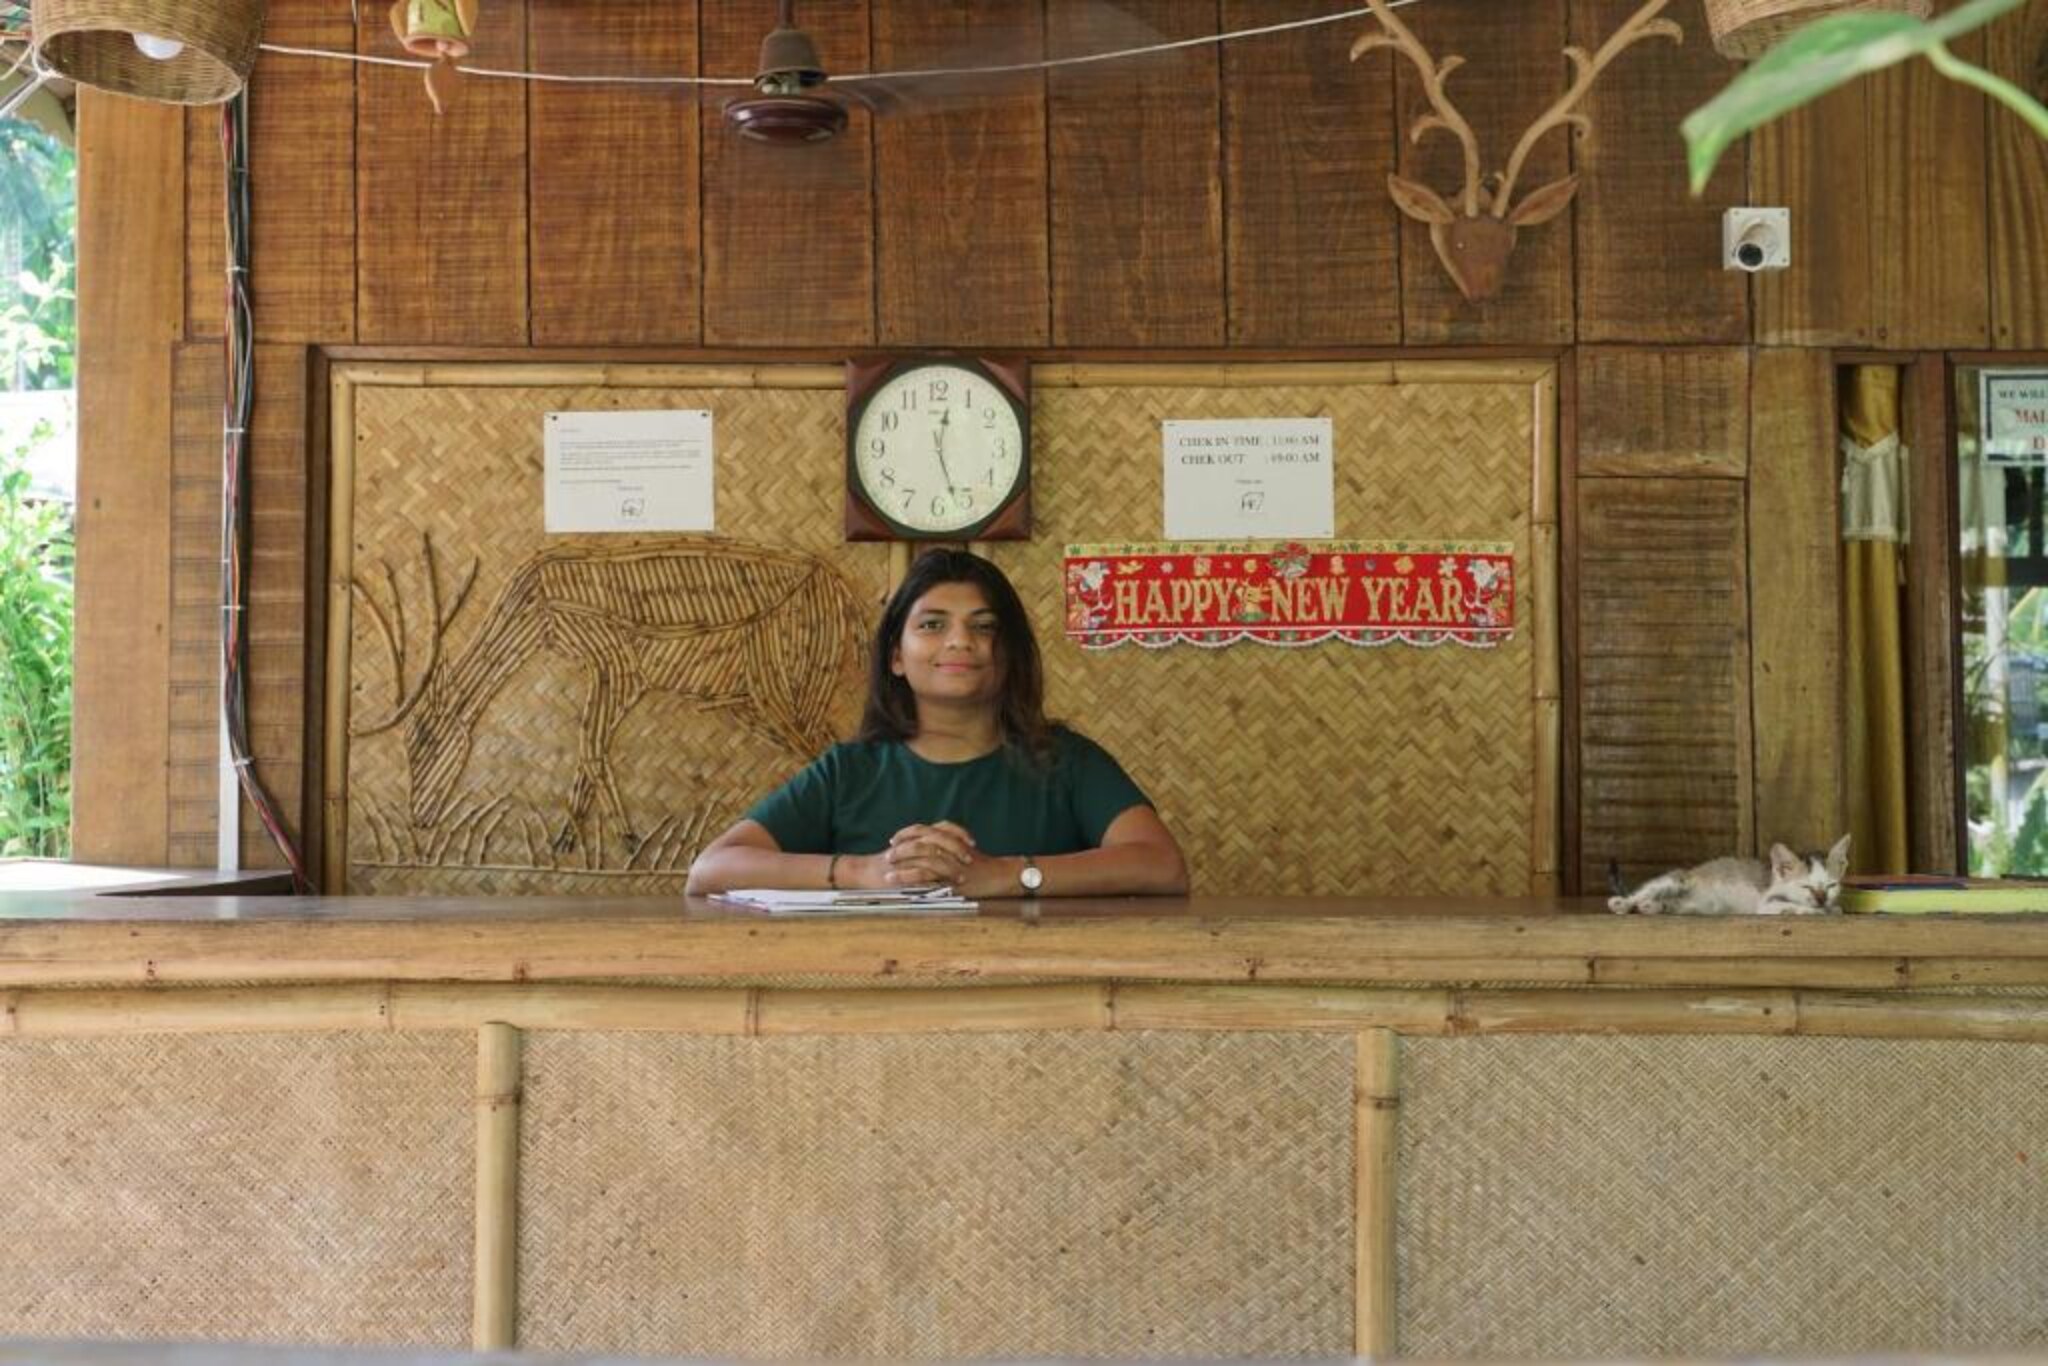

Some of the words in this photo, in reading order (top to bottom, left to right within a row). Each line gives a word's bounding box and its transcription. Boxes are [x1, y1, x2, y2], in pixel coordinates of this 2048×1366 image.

[902, 389, 917, 410] 11
[928, 379, 949, 402] 12
[965, 388, 972, 409] 1
[881, 411, 899, 432] 10
[983, 407, 997, 429] 2
[871, 437, 885, 460] 9
[992, 437, 1006, 459] 3
[1217, 452, 1247, 465] OUT
[880, 467, 896, 488] 8
[984, 467, 994, 488] 4
[901, 488, 916, 509] 7
[930, 495, 945, 517] 6
[960, 487, 974, 510] 5
[1113, 578, 1236, 625] HAPPY
[1268, 576, 1352, 624] NEW
[1361, 574, 1466, 623] YEAR
